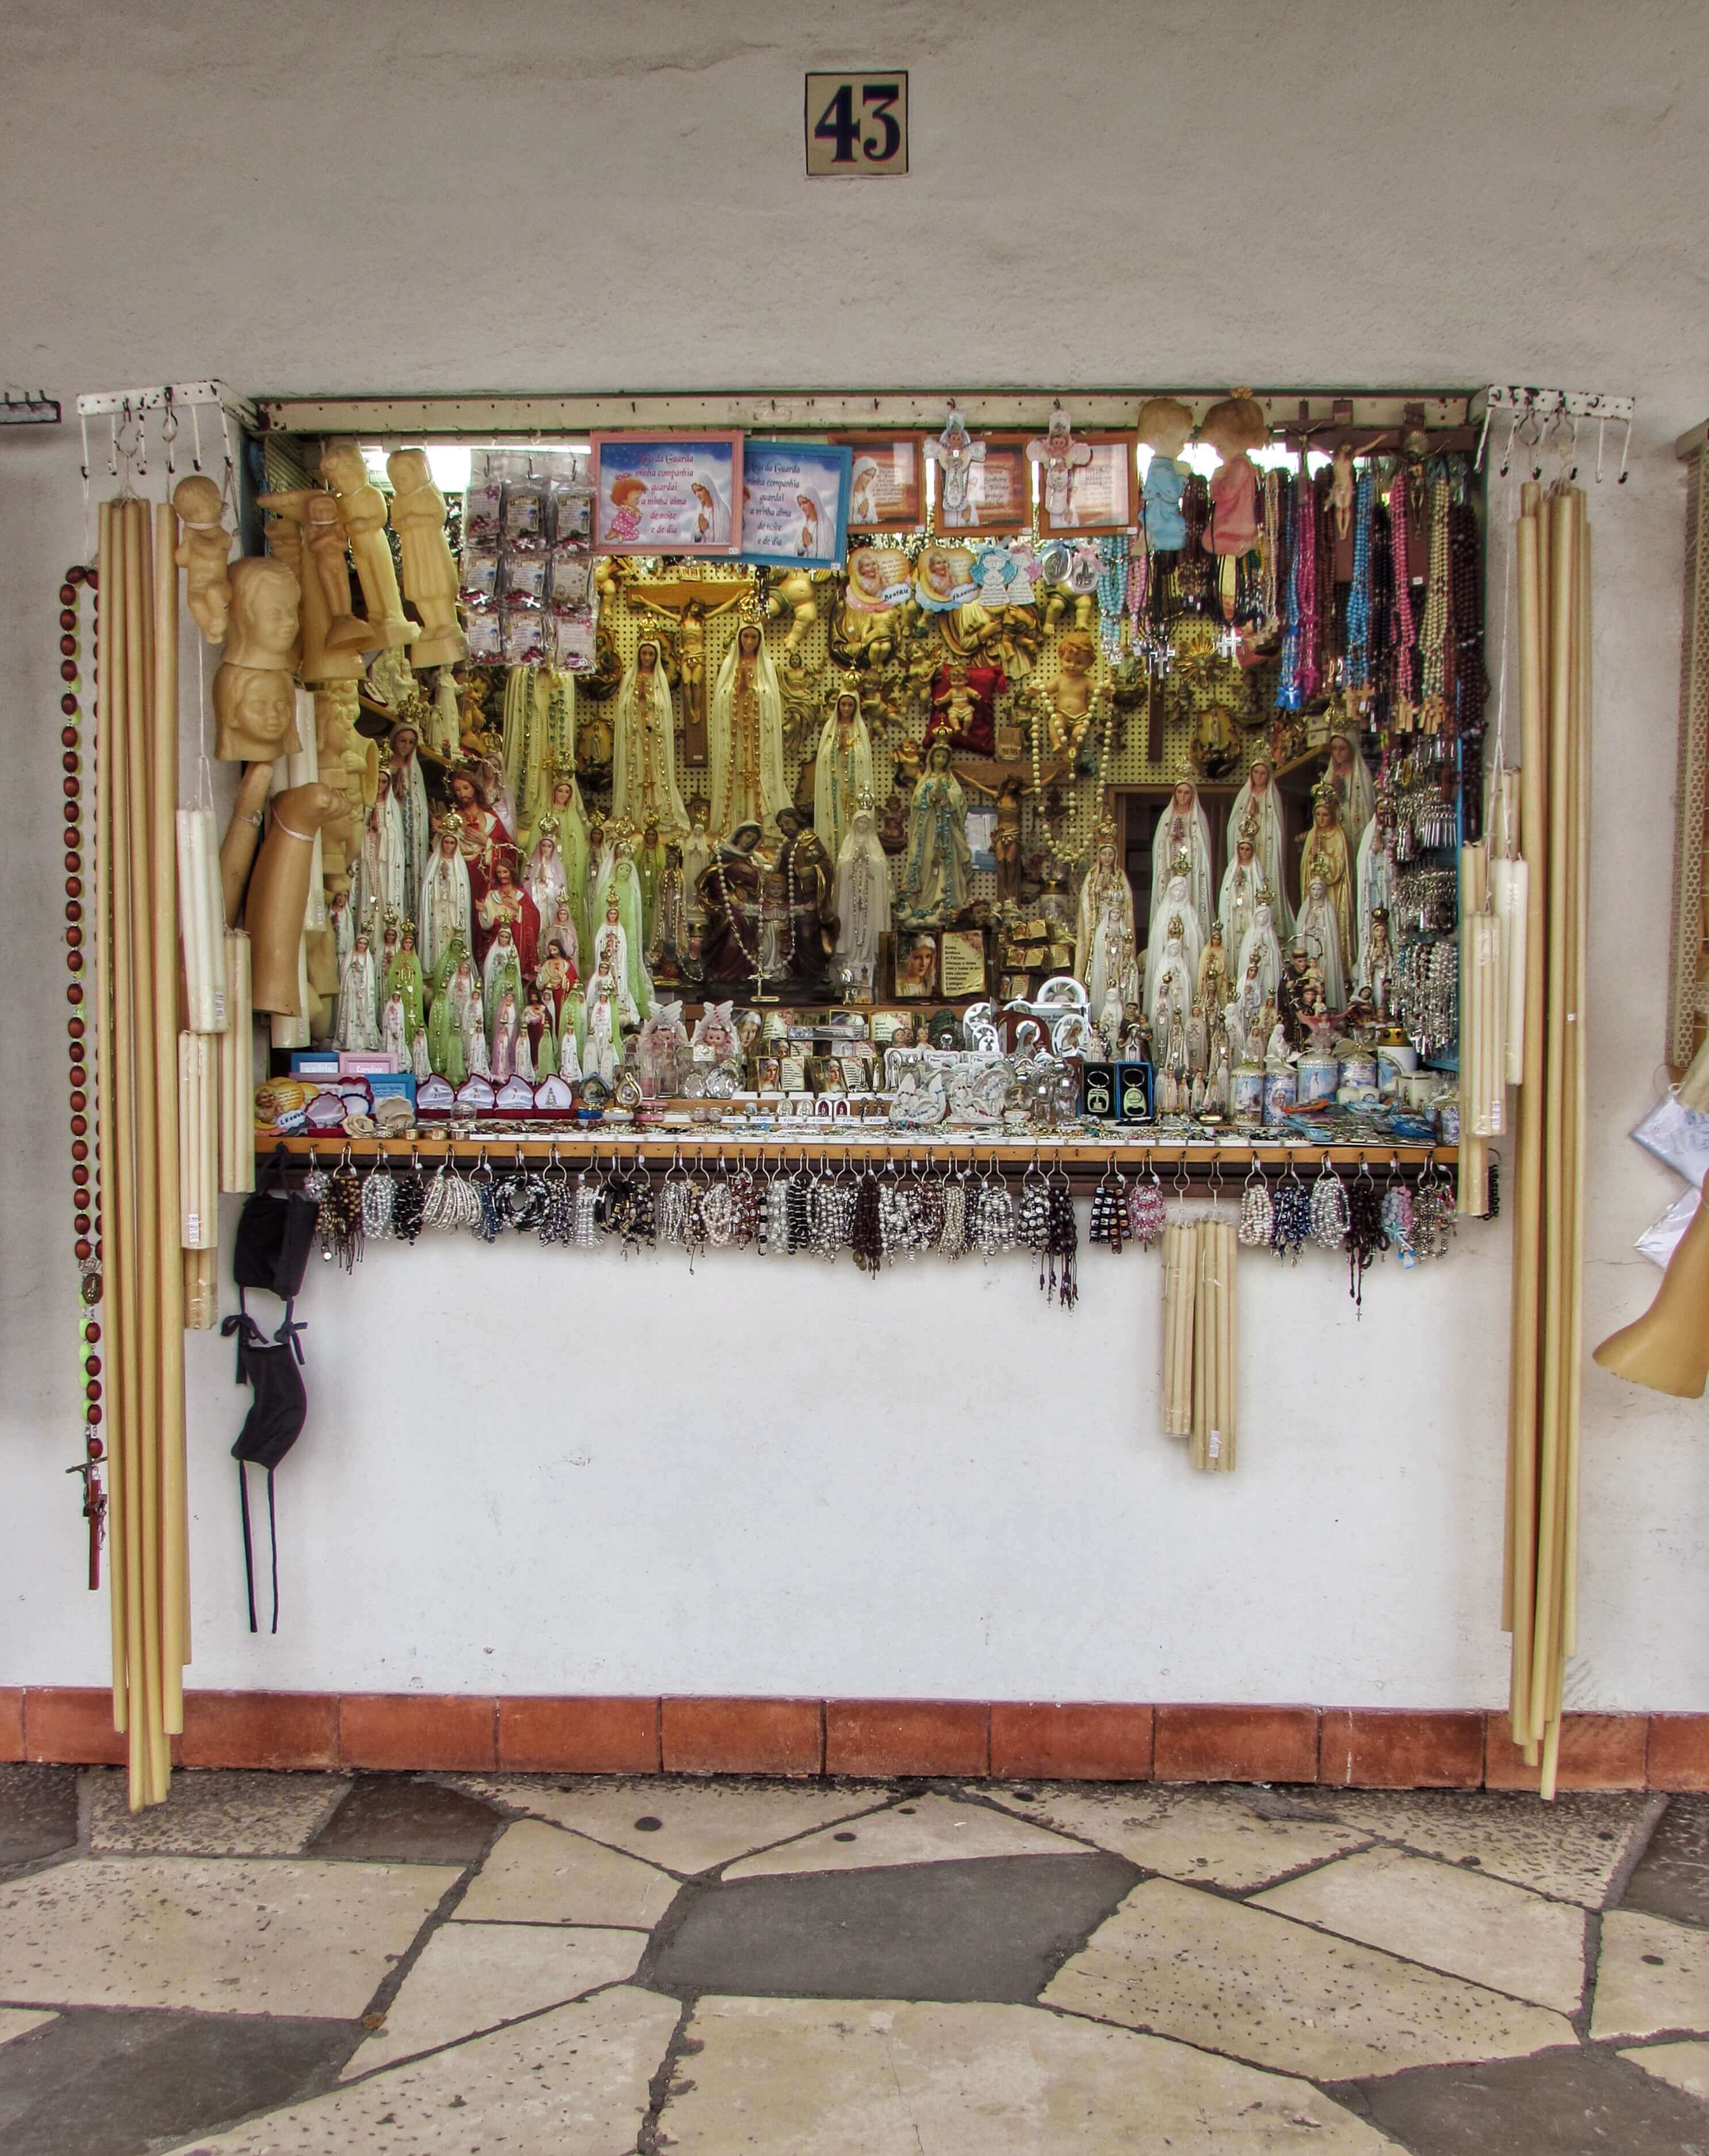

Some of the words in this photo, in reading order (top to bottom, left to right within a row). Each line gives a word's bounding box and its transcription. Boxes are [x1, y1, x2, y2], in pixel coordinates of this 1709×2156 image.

[815, 84, 900, 163] 43
[656, 454, 663, 462] da
[665, 454, 693, 465] Guarda
[635, 467, 656, 477] minha
[658, 468, 693, 480] companhia
[765, 462, 773, 471] da
[774, 463, 800, 474] Guarda
[651, 482, 677, 494] guardai
[767, 478, 800, 490] companhia
[647, 496, 668, 505] minha
[670, 497, 686, 505] alma
[760, 493, 784, 505] guardai
[650, 511, 658, 520] de
[661, 511, 677, 520] noite
[756, 507, 775, 516] minha
[776, 508, 791, 517] alma
[657, 525, 665, 534] de
[666, 525, 677, 534] dia
[757, 521, 765, 530] de
[767, 521, 782, 531] noite
[763, 536, 771, 546] de
[772, 536, 782, 546] dia
